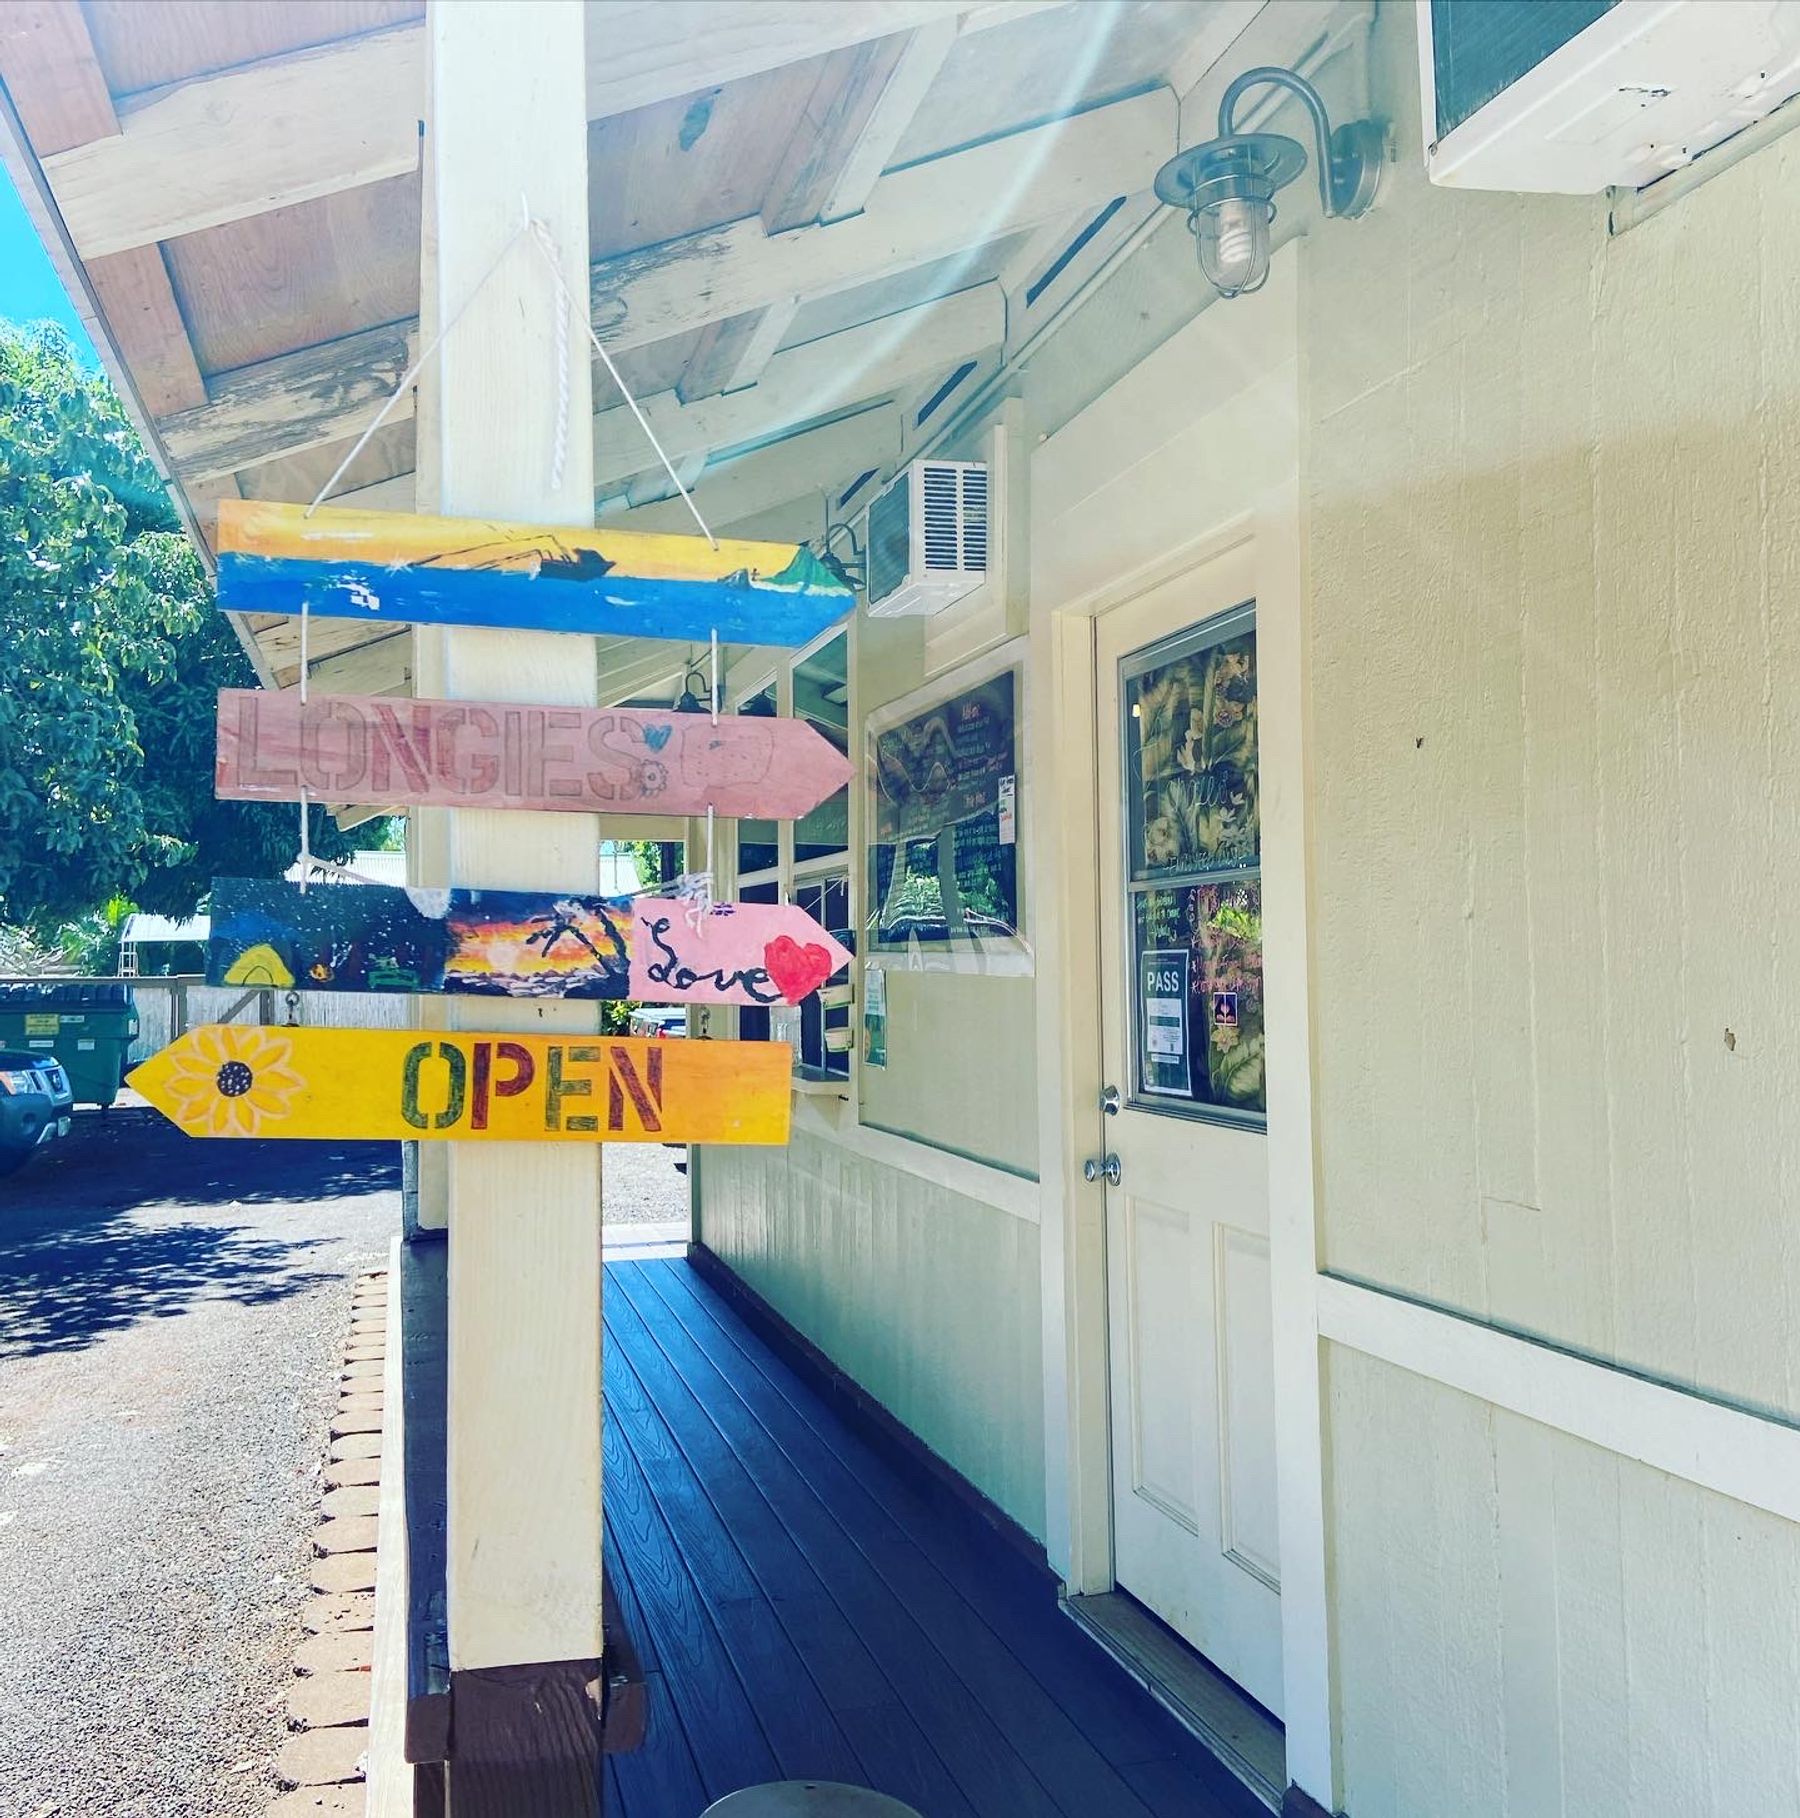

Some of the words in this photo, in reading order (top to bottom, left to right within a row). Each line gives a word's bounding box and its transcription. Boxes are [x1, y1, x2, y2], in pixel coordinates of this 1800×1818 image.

[237, 697, 646, 800] LONGIES
[641, 917, 783, 1003] Love
[1147, 970, 1179, 992] PASS
[401, 1041, 662, 1132] OPEN
